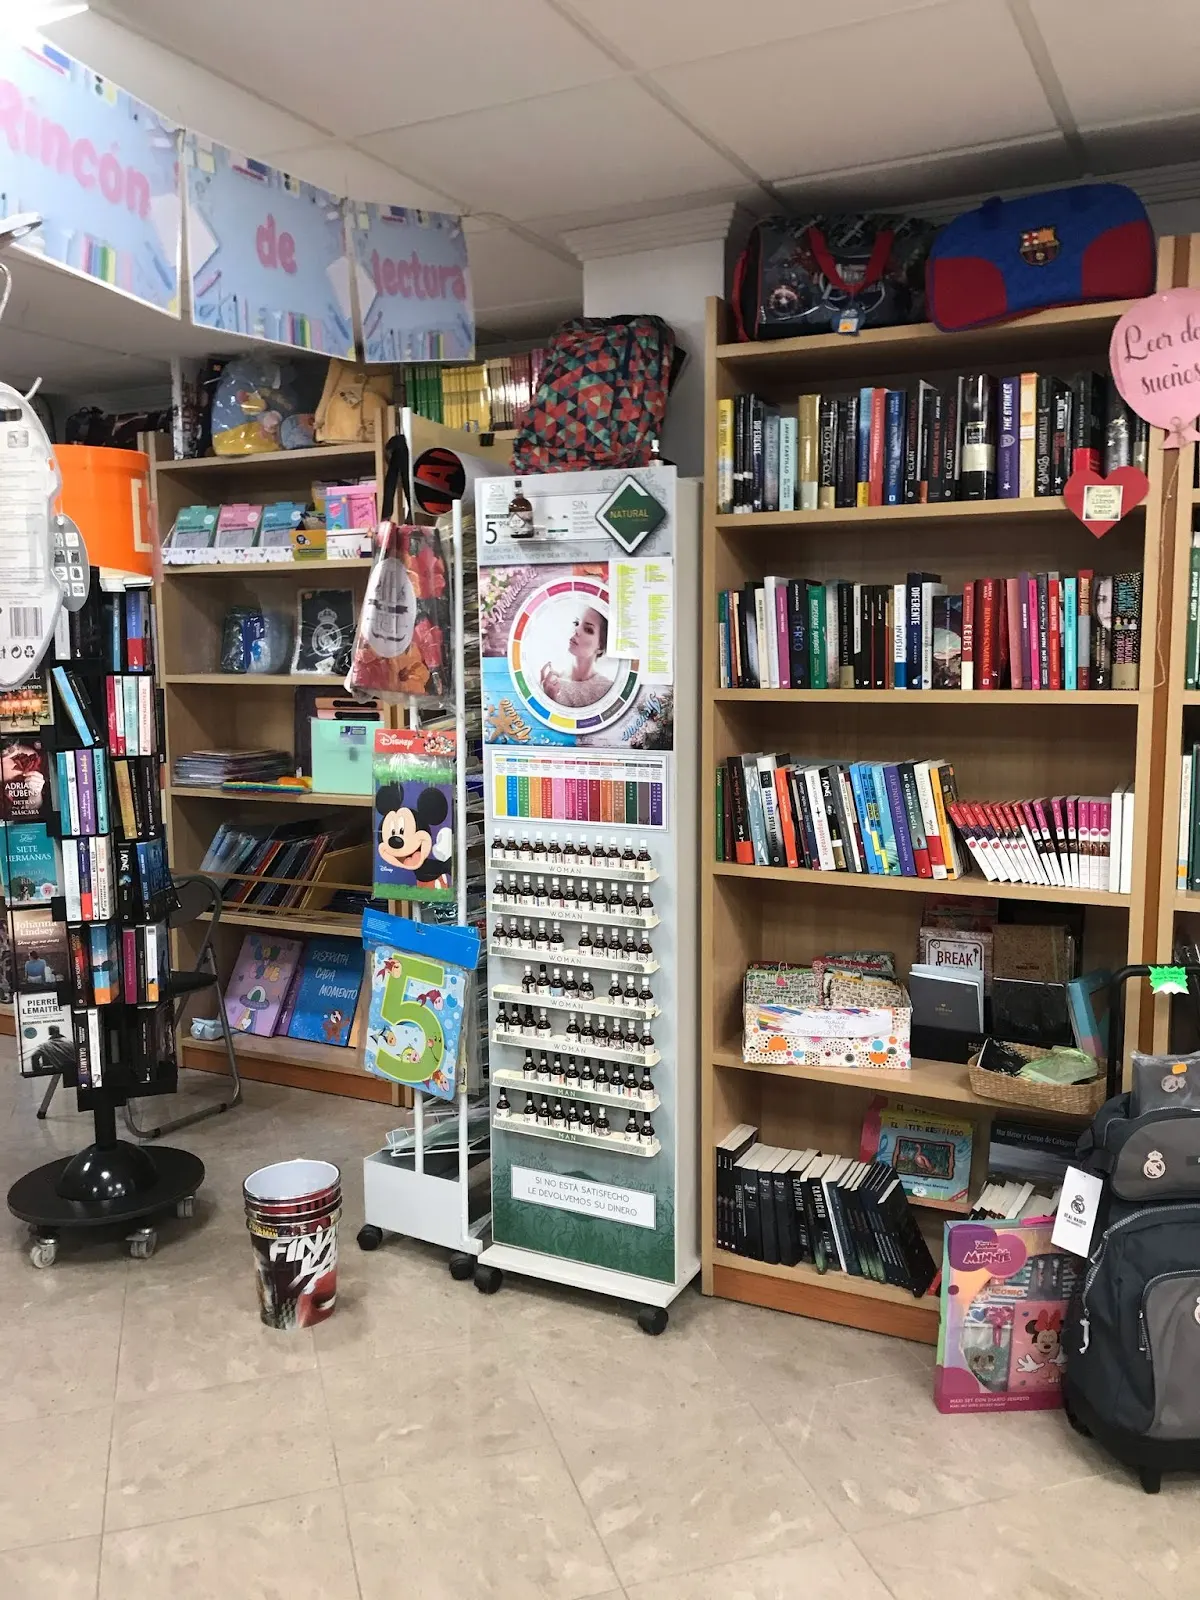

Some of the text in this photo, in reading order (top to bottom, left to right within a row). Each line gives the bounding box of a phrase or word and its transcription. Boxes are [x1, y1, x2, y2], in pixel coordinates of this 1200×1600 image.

[0, 78, 152, 220] Rincón
[255, 213, 298, 275] de
[371, 248, 467, 301] lectura
[1124, 324, 1173, 364] Leer
[1141, 361, 1200, 396] sueños
[1003, 383, 1012, 431] THE STRIKER
[753, 420, 762, 456] DIFERENTE
[823, 426, 832, 456] ROMA
[908, 470, 914, 480] EL
[946, 470, 952, 479] EL
[610, 510, 648, 518] NATURAL
[485, 522, 497, 544] 5
[911, 587, 920, 625] DIFERENTE
[963, 624, 972, 651] REDES
[377, 732, 414, 750] Disney
[822, 776, 832, 797] KING
[889, 774, 900, 805] LUCINDA
[764, 790, 773, 806] BESOS
[894, 805, 903, 823] RILEY
[904, 783, 914, 810] QUERIDA
[909, 811, 918, 830] LUCÍA
[6, 854, 51, 862] HERMANAS
[117, 854, 128, 871] KING
[551, 912, 583, 920] WOMAN
[15, 920, 57, 930] Johanna
[20, 927, 54, 936] Lindsey
[312, 951, 350, 965] DISFRUTA
[548, 955, 582, 964] WOMAN
[937, 950, 973, 966] BREAK
[315, 968, 336, 981] CADA
[319, 985, 357, 999] MOMENTO
[22, 1006, 63, 1014] LEMAITRE
[27, 998, 57, 1006] PIERRE
[551, 1000, 584, 1009] WOMAN
[375, 953, 445, 1084] 5
[554, 1044, 586, 1053] WOMAN
[558, 1089, 576, 1097] MAN
[558, 1132, 576, 1141] MAN
[1007, 1130, 1021, 1139] Menor
[1027, 1133, 1044, 1143] Campo
[545, 1179, 557, 1187] NO
[560, 1182, 578, 1192] ESTÁ
[582, 1187, 630, 1203] SATISFECHO
[792, 1178, 804, 1212] CAPRICHO
[538, 1189, 591, 1206] DEVOLVEMOS
[594, 1200, 605, 1209] SU
[608, 1204, 637, 1216] DINERO
[811, 1185, 826, 1219] CAPRICHO
[963, 1249, 1011, 1264] MINNIE
[991, 1288, 1023, 1296] ICONIC
